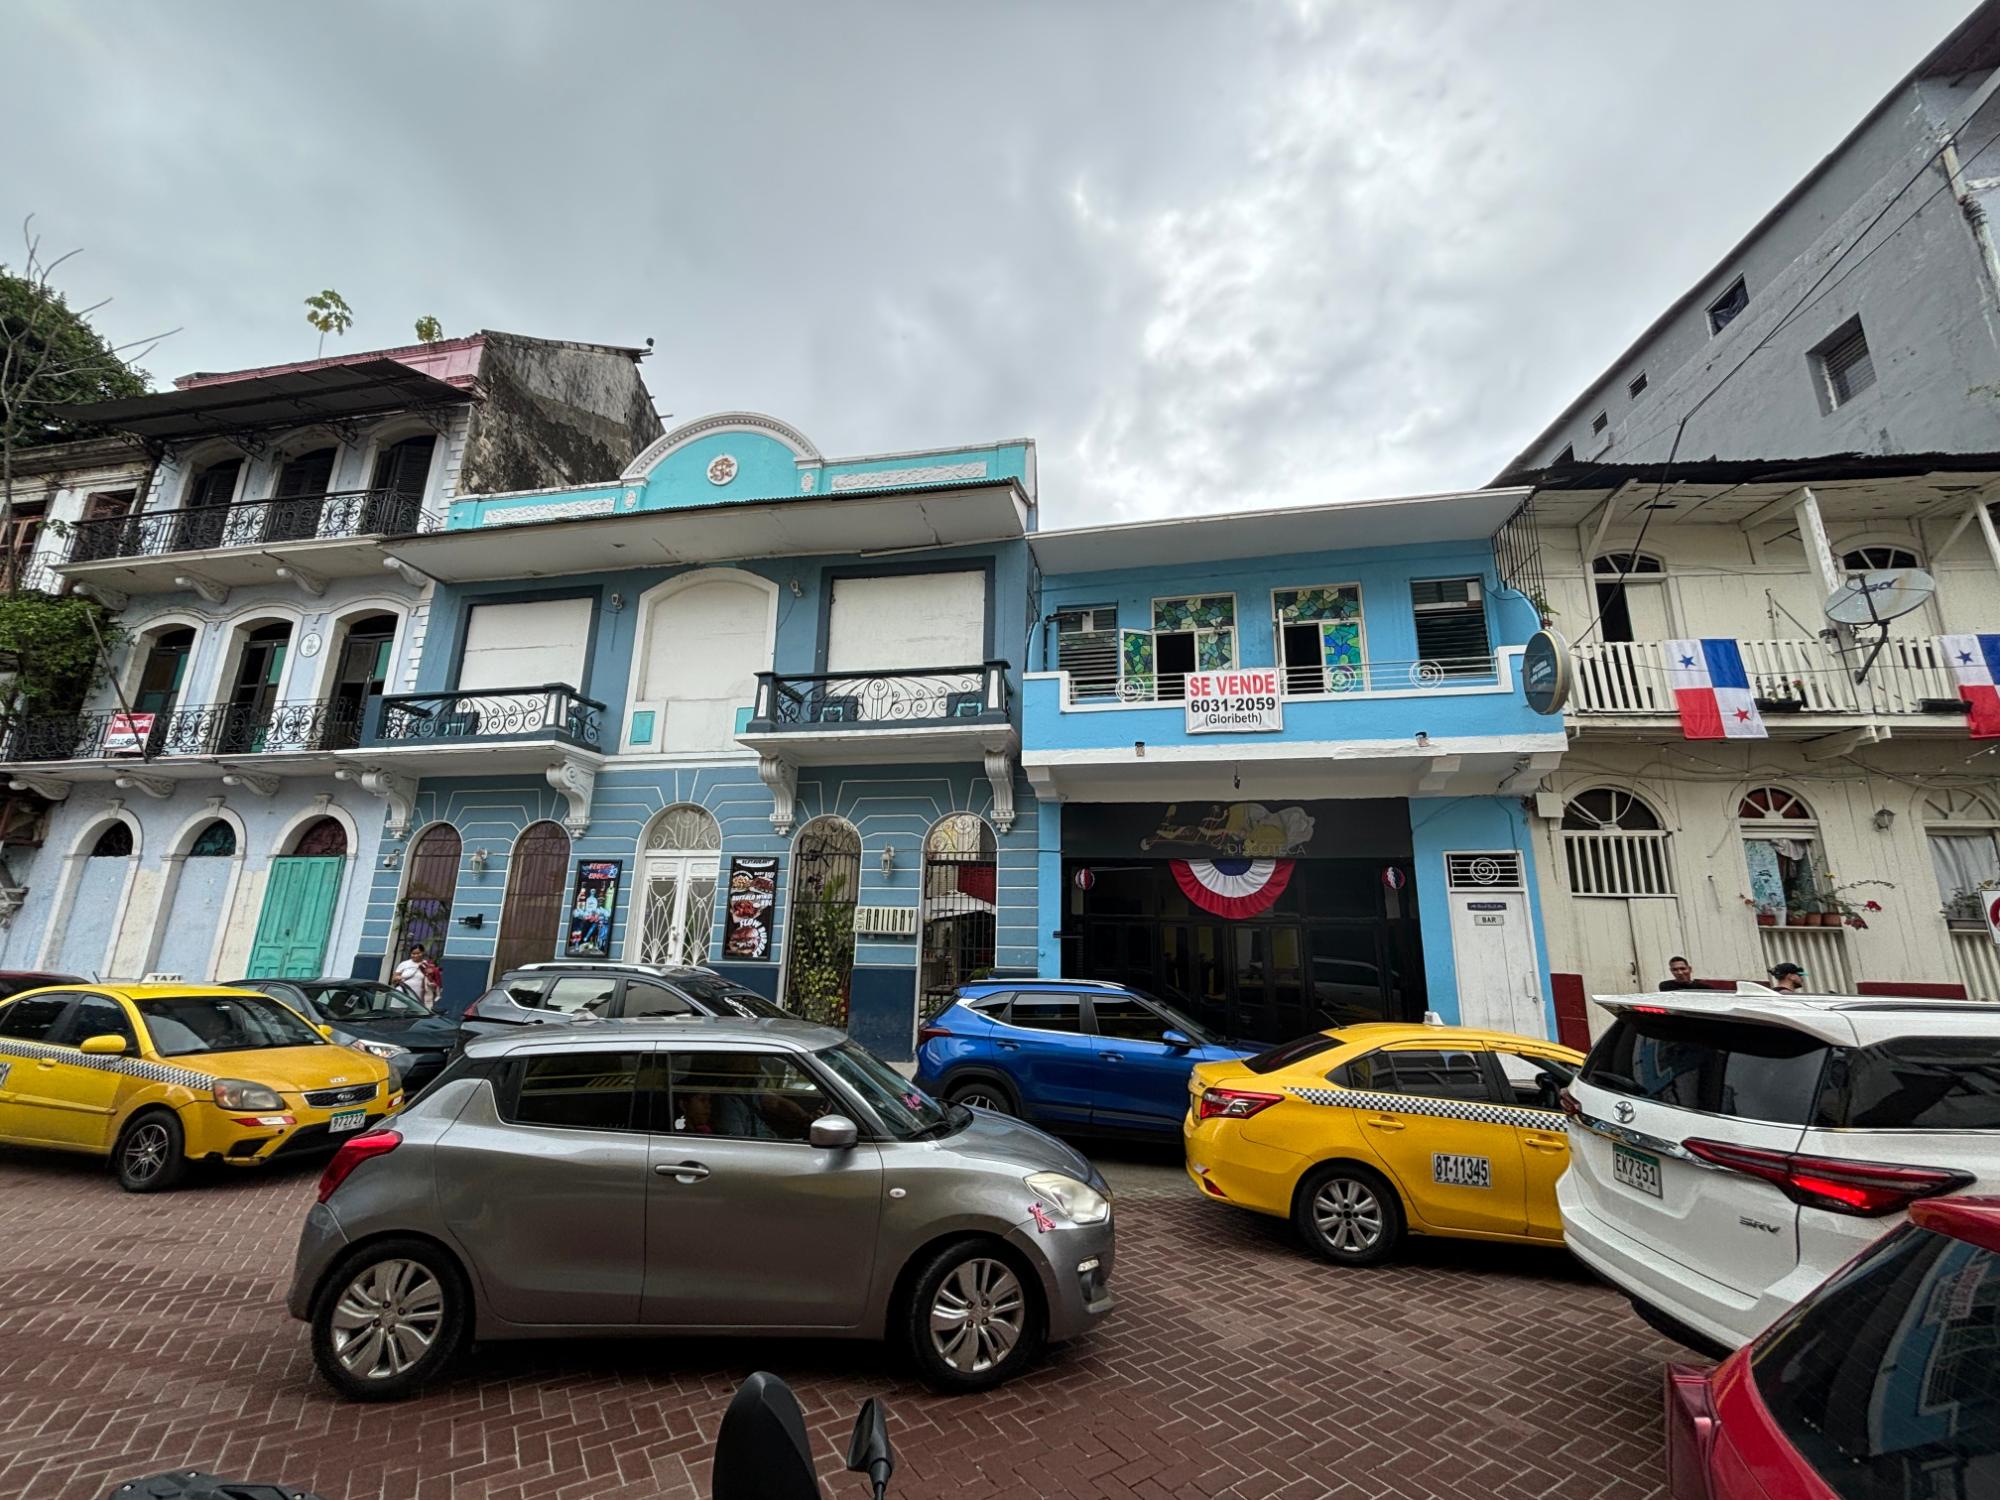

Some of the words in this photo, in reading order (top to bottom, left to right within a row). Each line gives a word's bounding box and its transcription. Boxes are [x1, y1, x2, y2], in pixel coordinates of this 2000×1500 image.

[1189, 677, 1211, 697] SE
[1216, 674, 1275, 696] VENDE
[1191, 697, 1275, 713] 6031-2059
[1205, 712, 1262, 727] (Gloribeth)
[1227, 843, 1307, 856] DISCOTECA
[740, 918, 762, 928] FLOW
[1481, 916, 1496, 924] BAR
[1436, 1155, 1488, 1181] 8T-11345
[1616, 1152, 1657, 1187] EK7351
